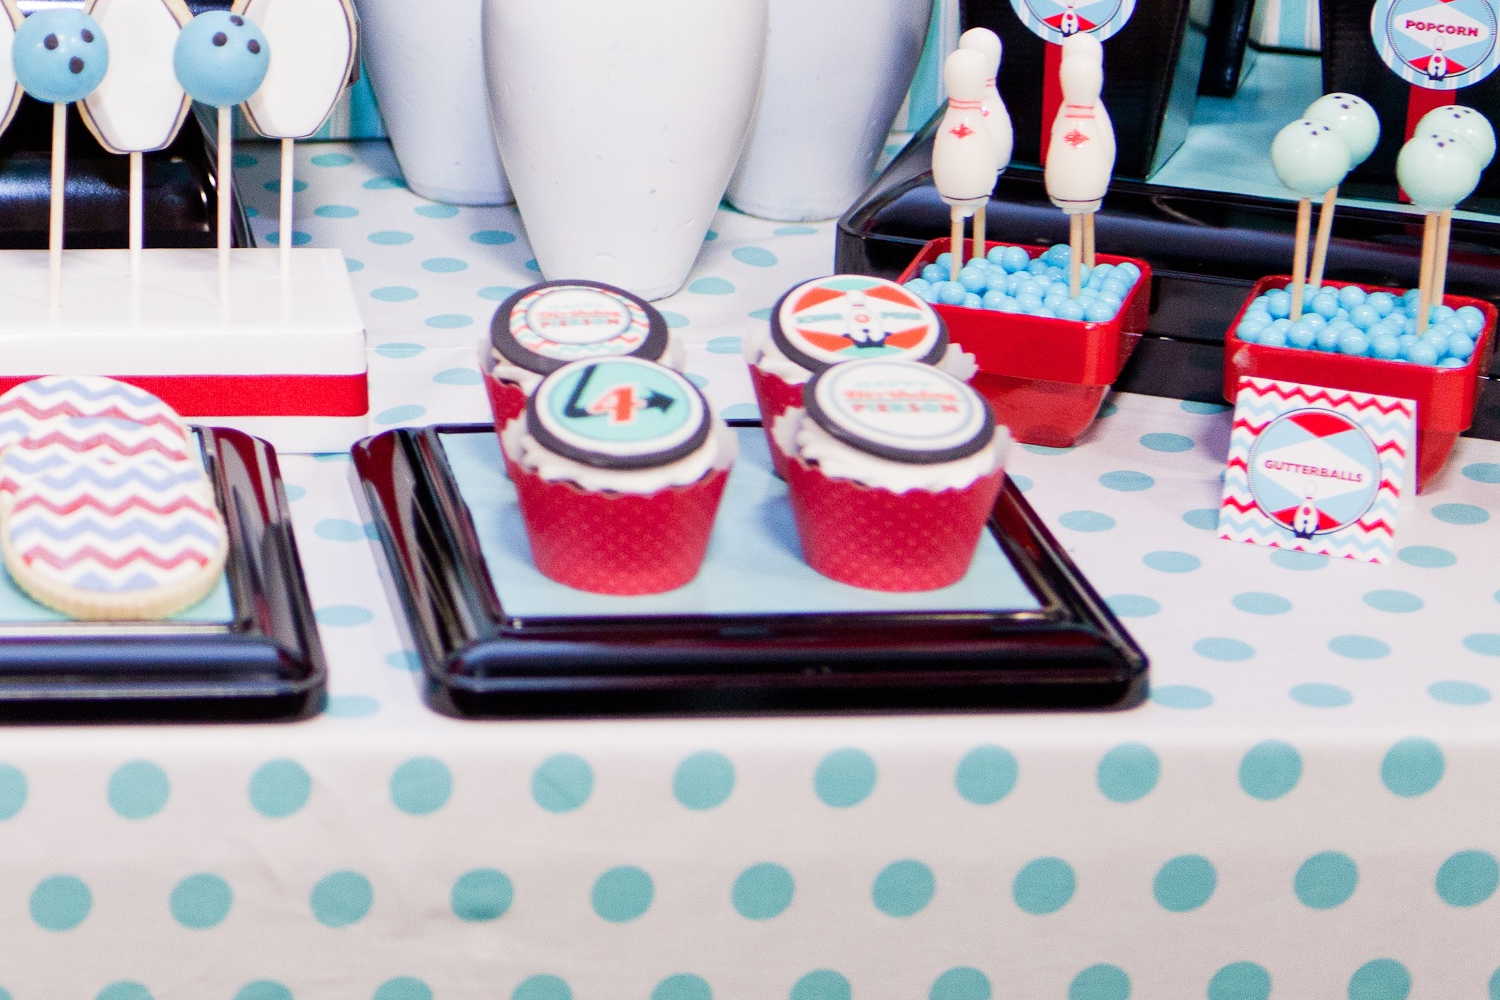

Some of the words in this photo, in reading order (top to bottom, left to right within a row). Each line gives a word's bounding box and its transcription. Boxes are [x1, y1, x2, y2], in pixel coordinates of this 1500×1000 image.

[1404, 18, 1480, 38] POPCORN
[588, 384, 643, 424] 4
[1263, 458, 1364, 483] GUTTERBALLS
